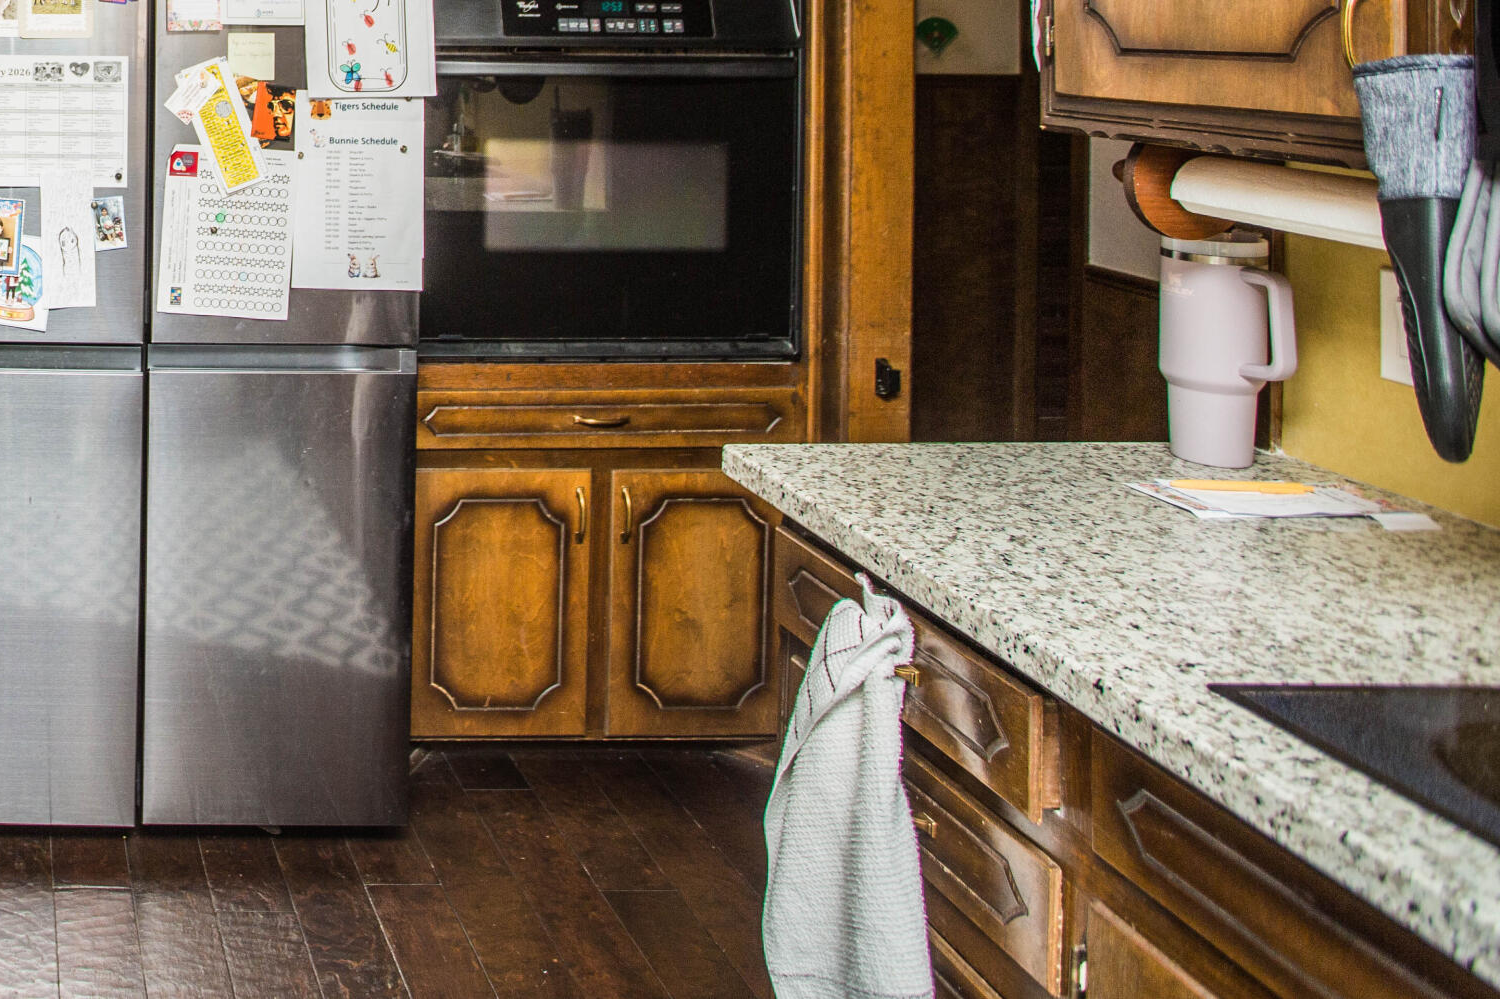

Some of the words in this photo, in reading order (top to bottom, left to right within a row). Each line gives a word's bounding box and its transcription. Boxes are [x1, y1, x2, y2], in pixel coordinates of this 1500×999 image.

[8, 68, 31, 77] 2026
[334, 102, 359, 111] Tigers
[361, 102, 399, 111] Schedule
[329, 136, 359, 145] Bunnie
[361, 137, 398, 145] Schedule
